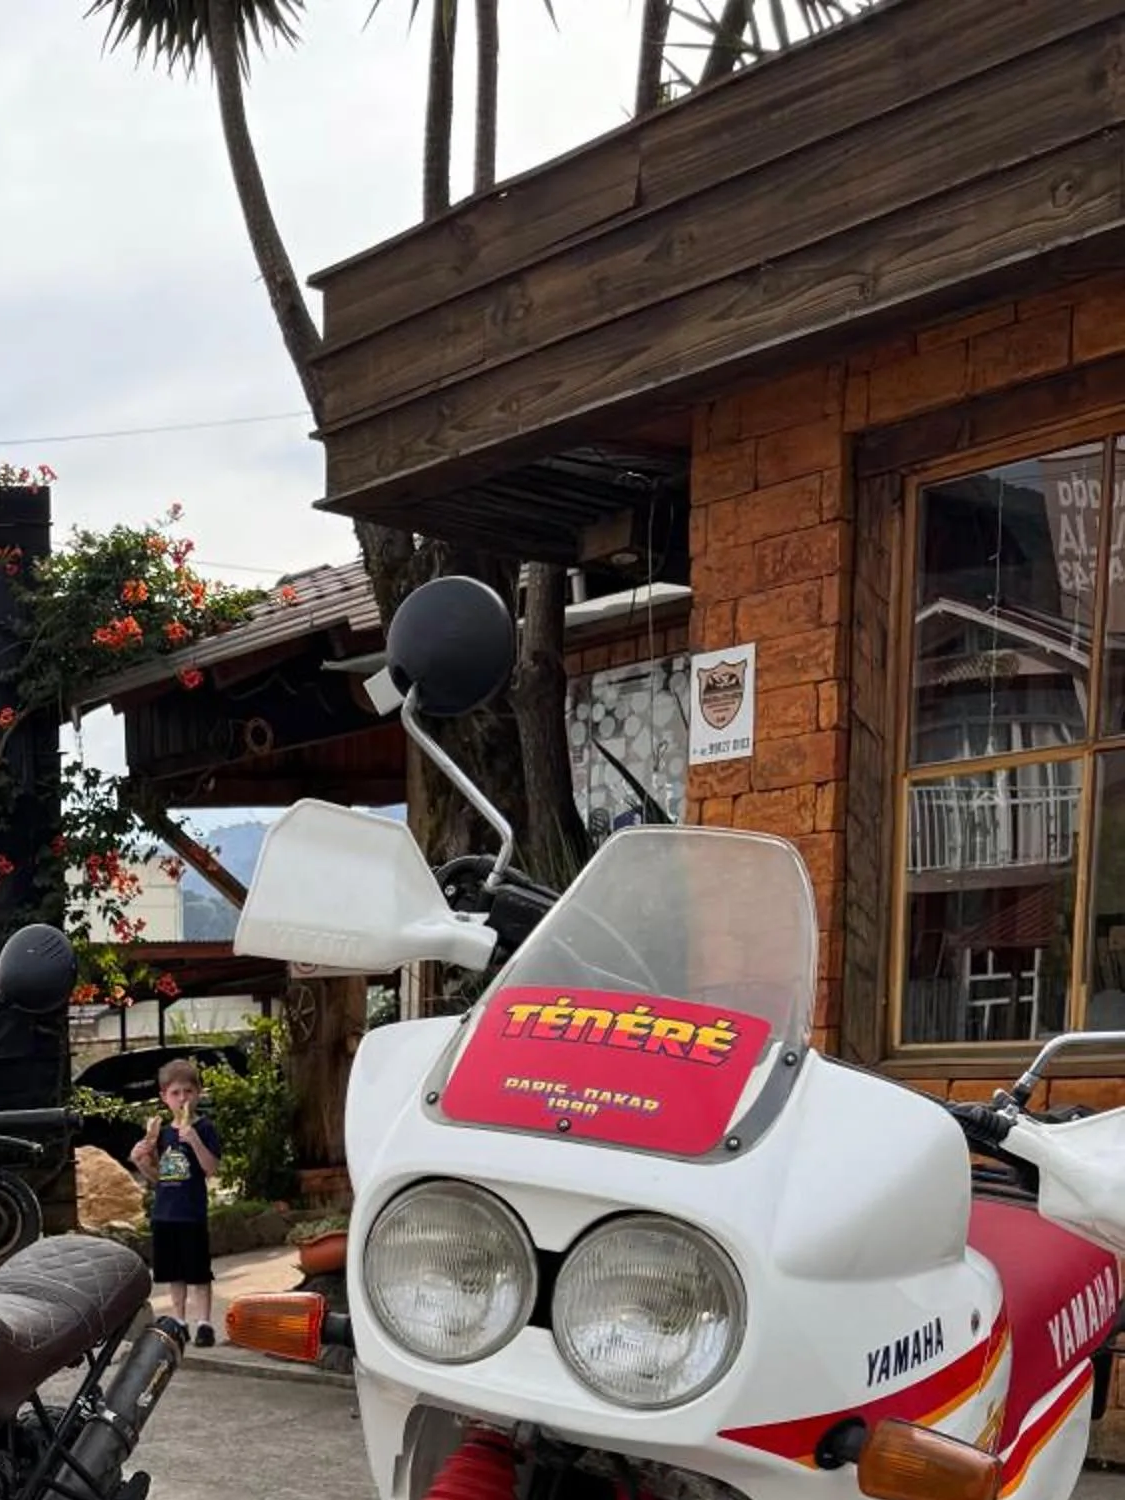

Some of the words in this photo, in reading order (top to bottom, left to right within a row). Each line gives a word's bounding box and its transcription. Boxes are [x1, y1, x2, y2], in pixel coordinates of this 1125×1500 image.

[547, 1096, 599, 1116] 1990
[867, 1317, 944, 1387] YAMAHA
[1048, 1266, 1116, 1369] YAMAHA
